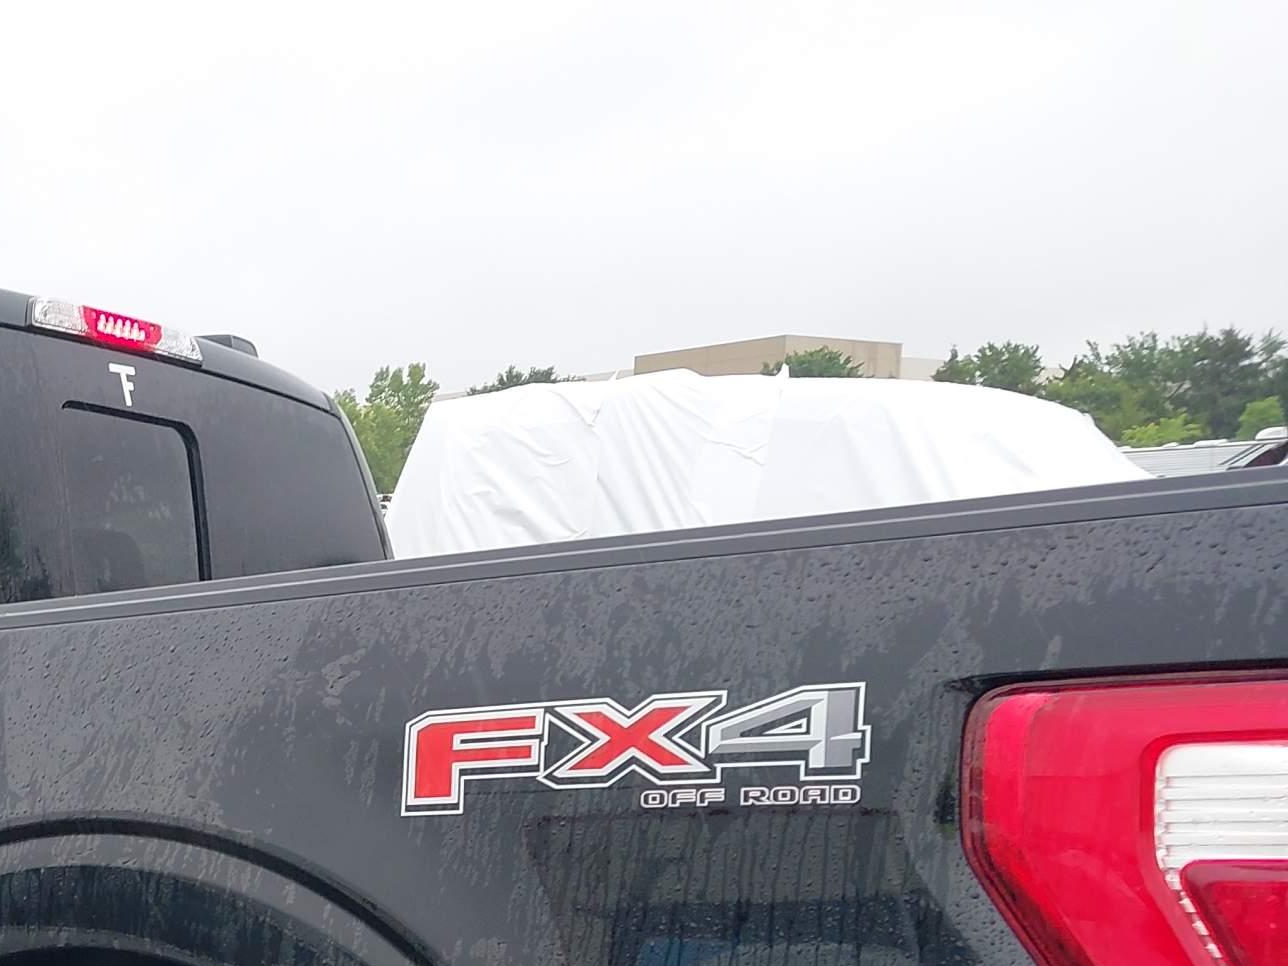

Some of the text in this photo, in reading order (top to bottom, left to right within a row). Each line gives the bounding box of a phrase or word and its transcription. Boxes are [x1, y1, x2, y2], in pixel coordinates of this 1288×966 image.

[402, 682, 871, 817] FX4
[640, 784, 861, 809] OFF ROAD
